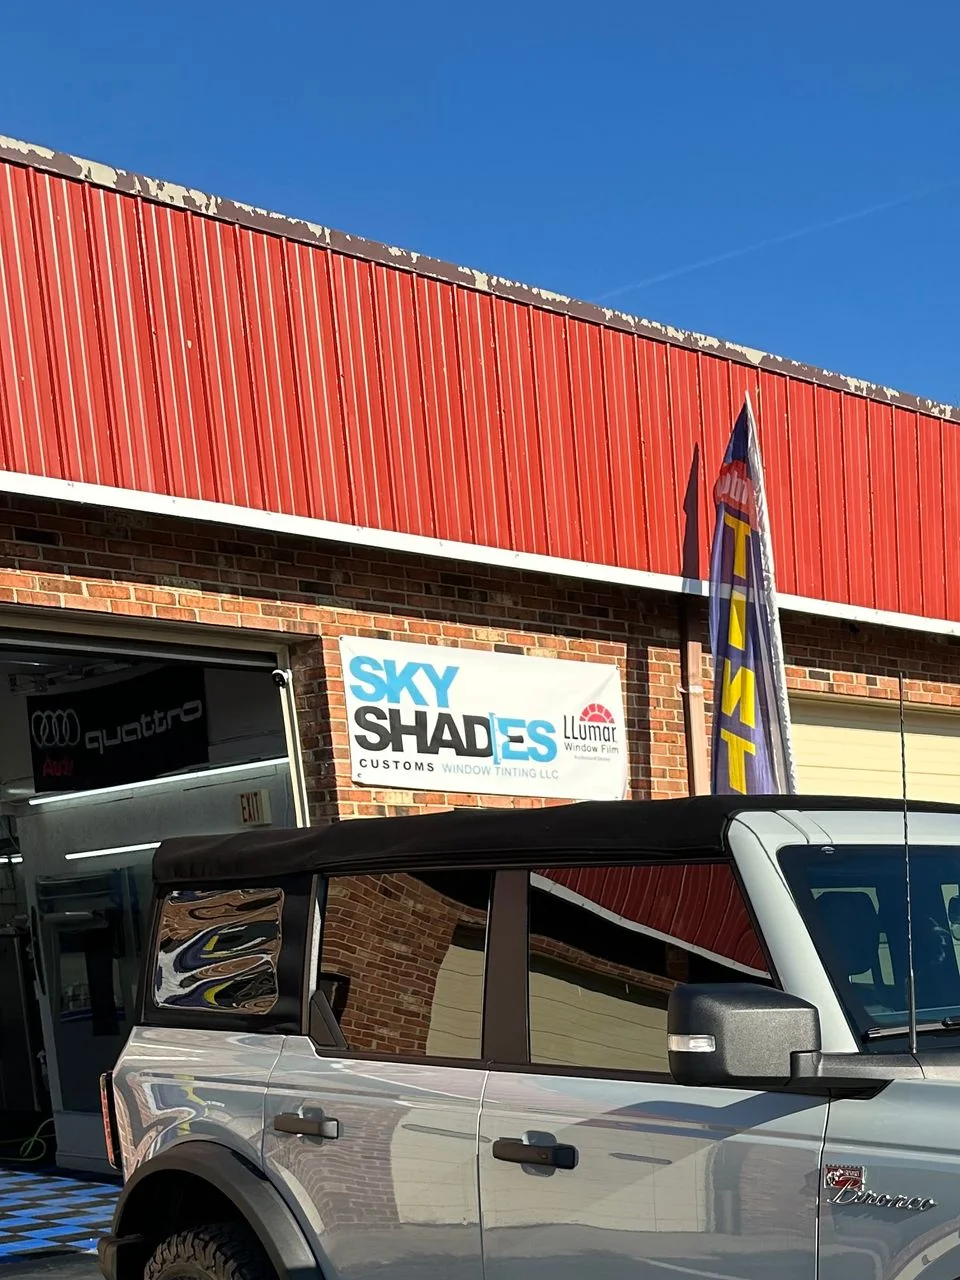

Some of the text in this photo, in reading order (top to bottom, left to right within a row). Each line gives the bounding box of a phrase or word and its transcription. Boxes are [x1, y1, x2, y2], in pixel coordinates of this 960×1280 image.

[349, 655, 460, 708] SKY
[84, 699, 203, 755] quattro
[354, 705, 558, 764] SHADES
[563, 714, 617, 742] LLumar
[563, 741, 619, 754] Window Film
[359, 758, 559, 780] CUSTOMS WINDOW TINTING LLC
[239, 791, 260, 823] EXIT
